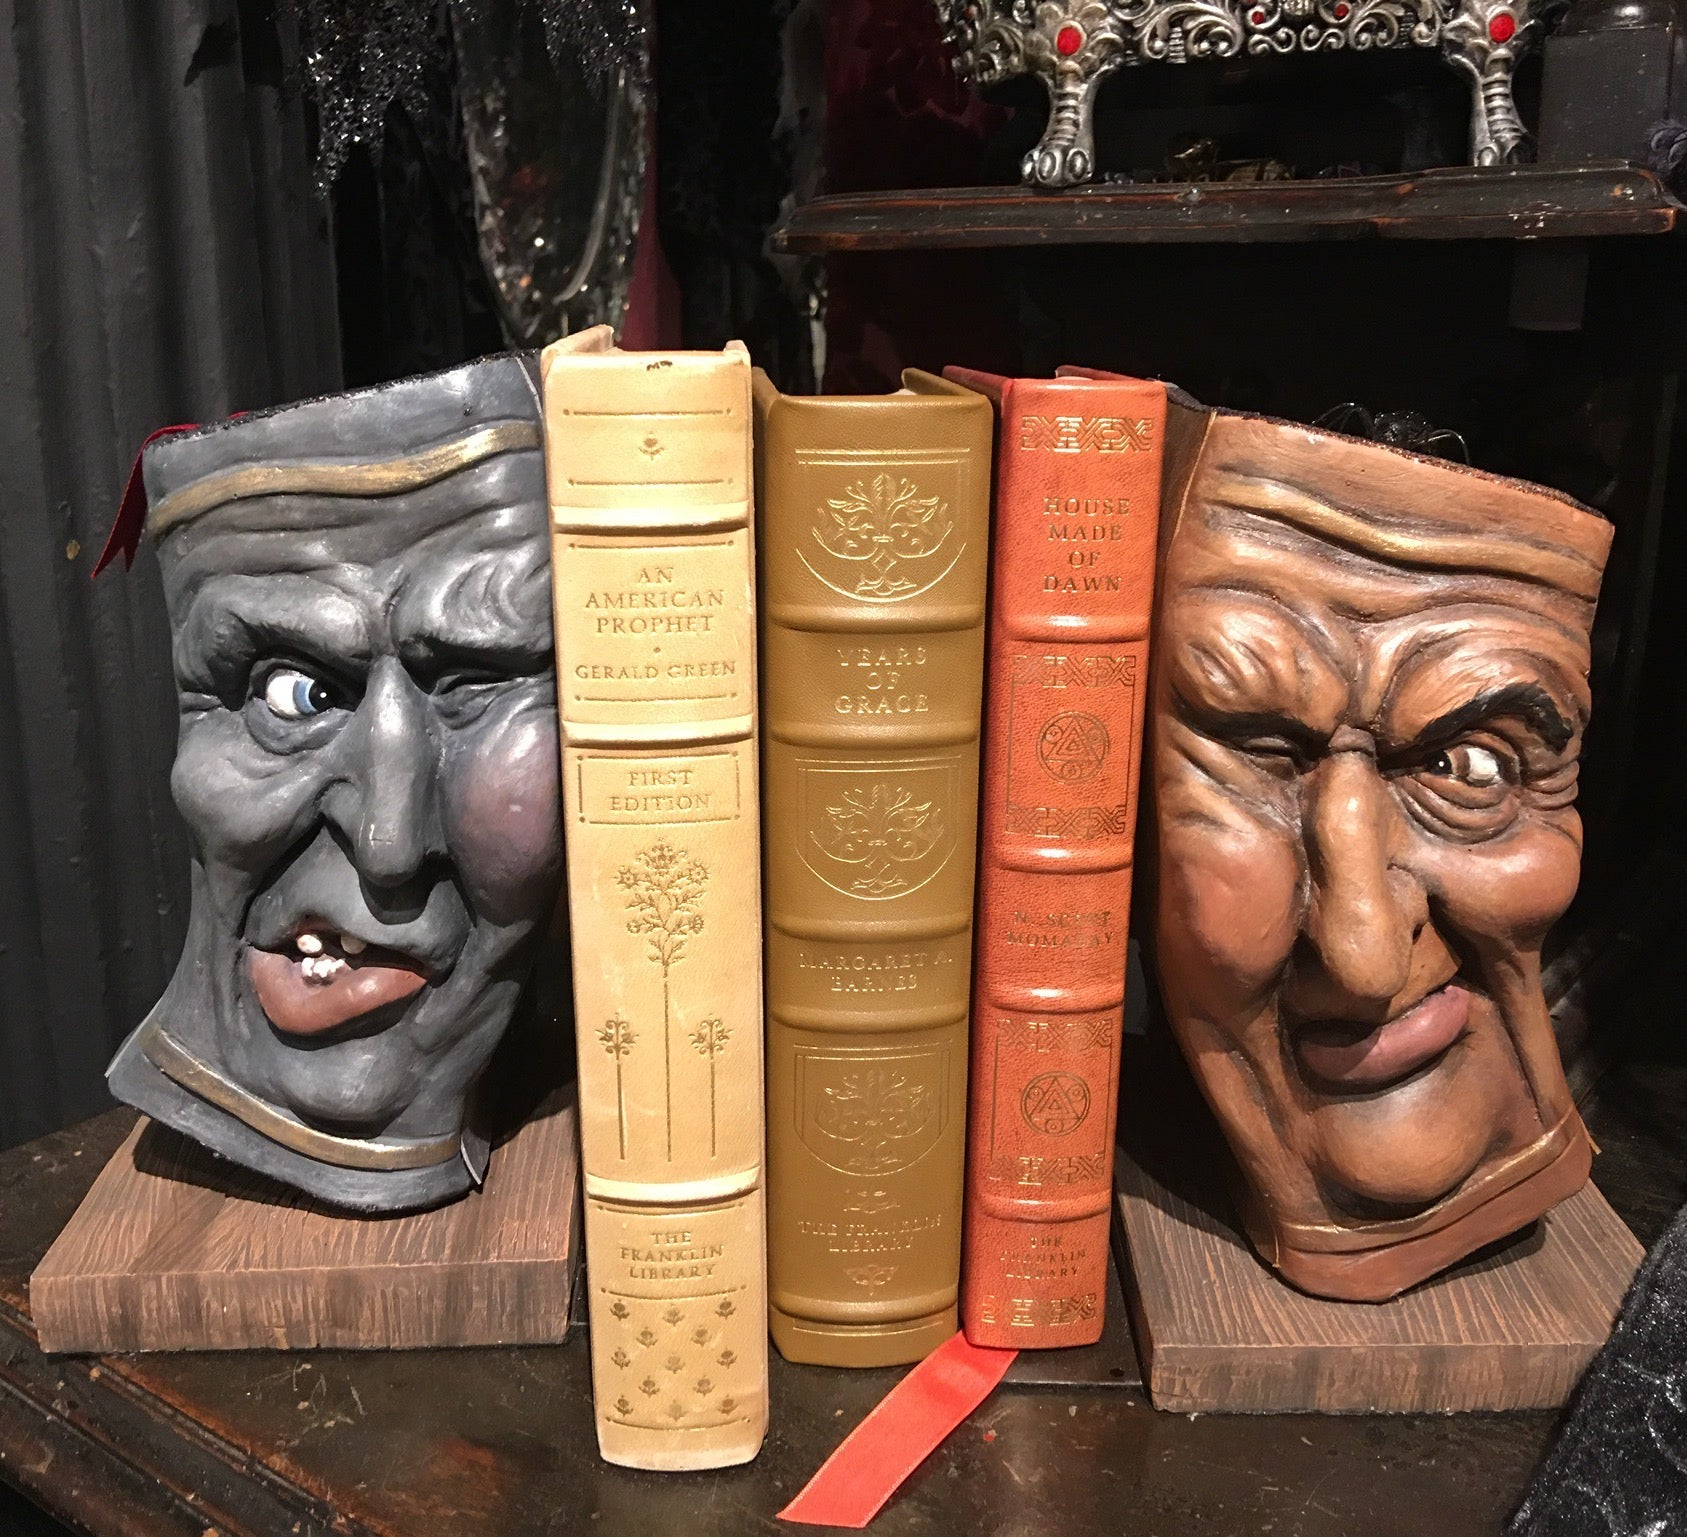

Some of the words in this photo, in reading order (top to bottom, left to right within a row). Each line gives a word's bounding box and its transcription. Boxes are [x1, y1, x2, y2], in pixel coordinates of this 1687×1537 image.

[1043, 498, 1130, 516] HOUSE
[1048, 524, 1122, 542] MADE
[1069, 551, 1101, 568] OF
[638, 567, 674, 584] AN
[1043, 575, 1122, 593] DAWN
[585, 589, 725, 609] AMERICAN
[596, 615, 714, 634] PROPHET
[836, 647, 927, 667] YEARS
[575, 664, 659, 680] GERALD
[667, 660, 736, 678] GREEN
[866, 671, 901, 690] OF
[835, 694, 929, 714] GRACE
[628, 770, 694, 787] FIRST
[609, 793, 713, 812] EDITION
[1046, 911, 1111, 927] SCT
[1007, 931, 1115, 948] MOMAAY
[651, 1231, 692, 1245] THE
[620, 1244, 723, 1263] FRANKLIN
[628, 1263, 716, 1280] LIBRARY
